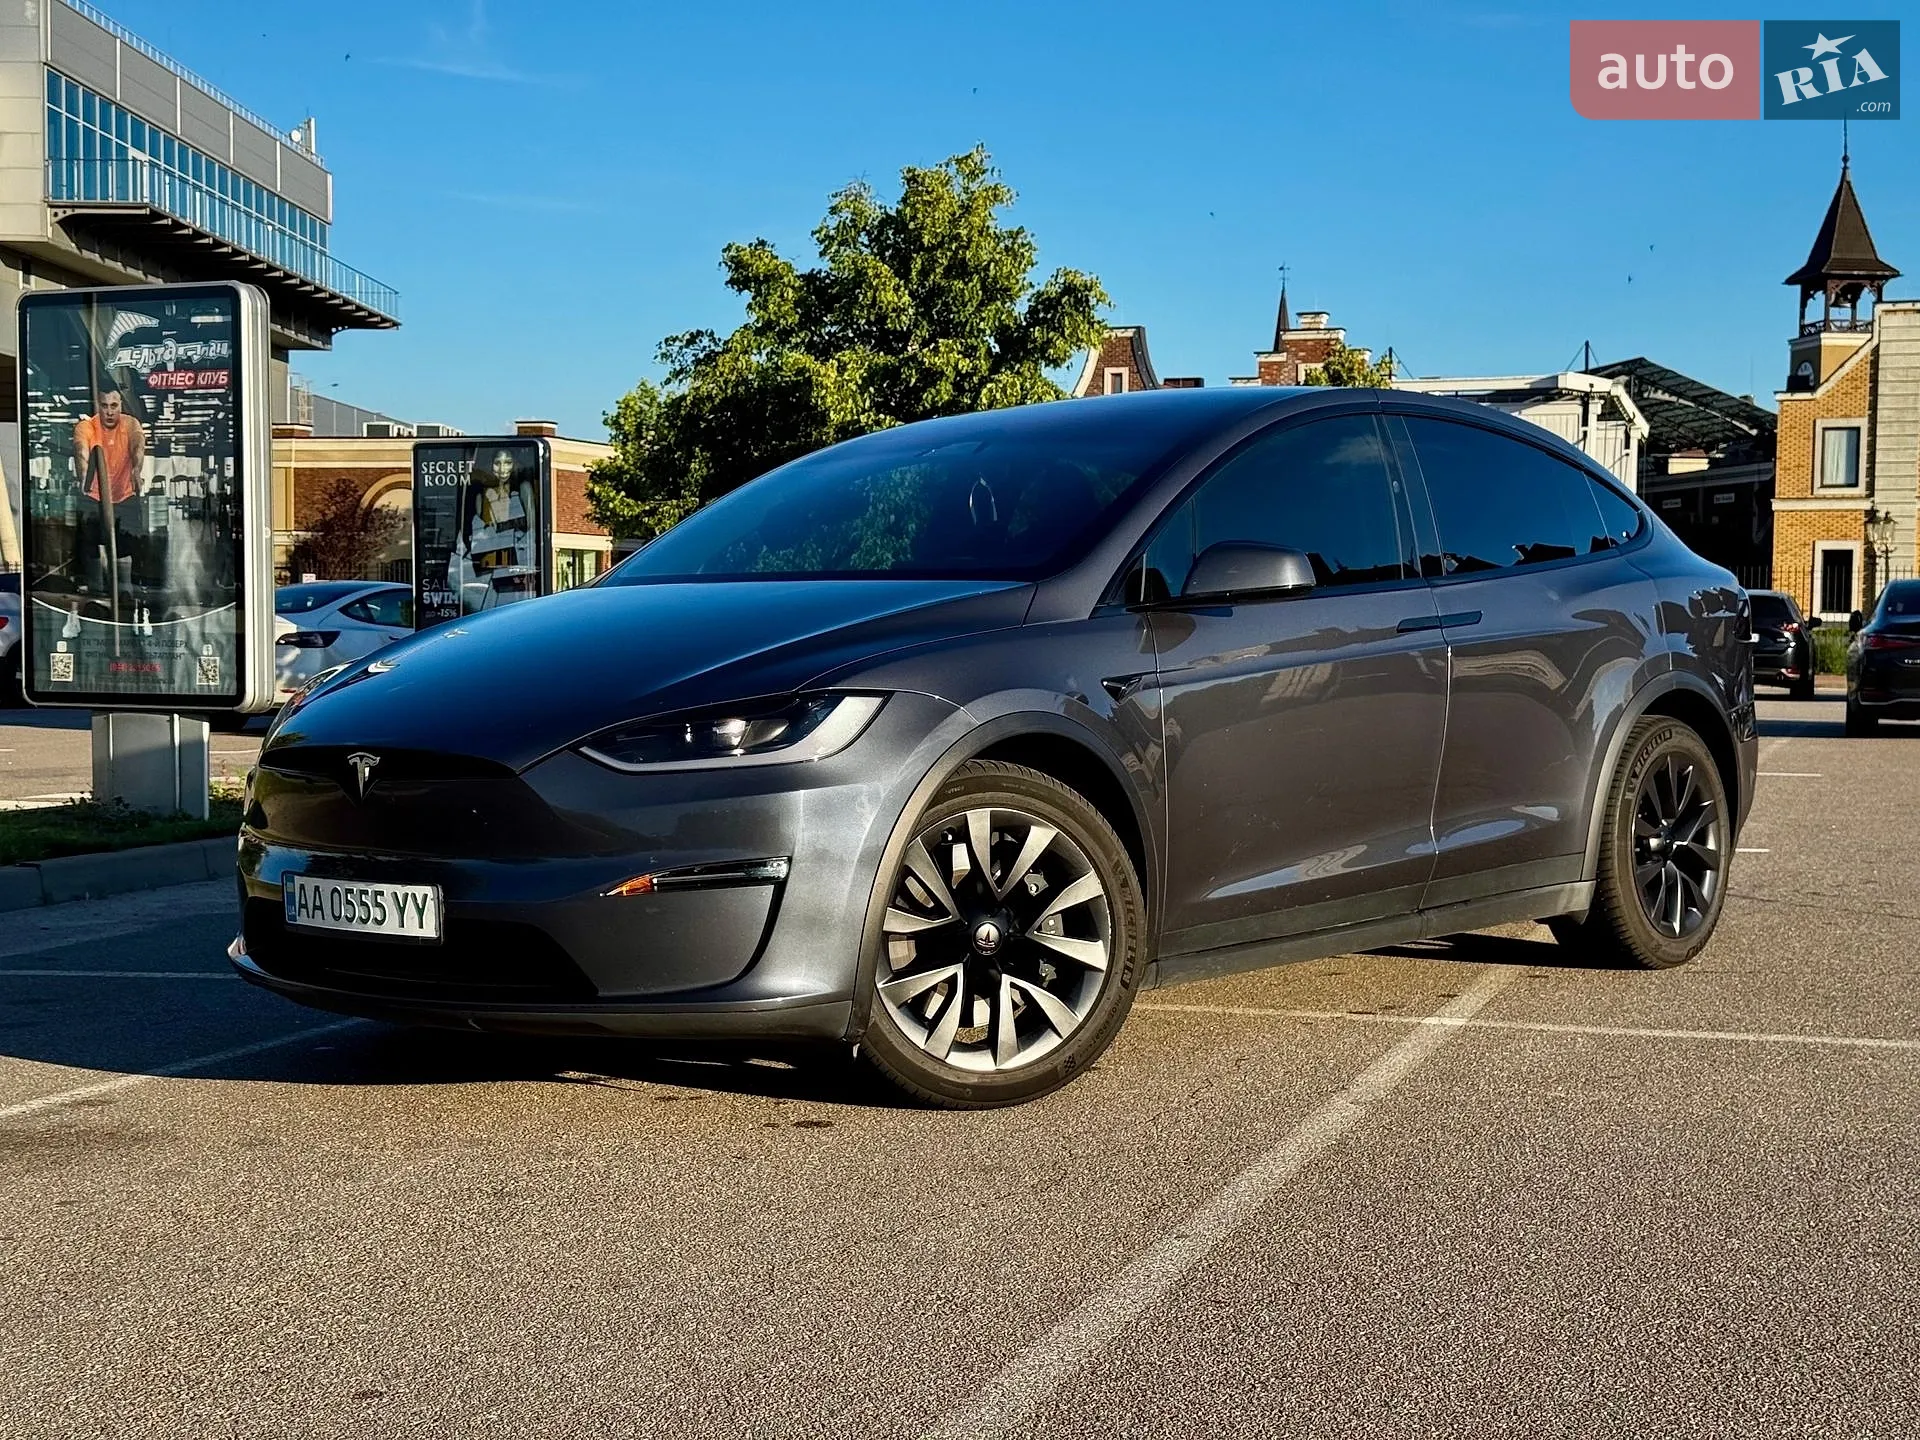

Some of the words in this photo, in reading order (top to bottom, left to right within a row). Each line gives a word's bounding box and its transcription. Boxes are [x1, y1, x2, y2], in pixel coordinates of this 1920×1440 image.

[148, 372, 195, 386] ФІТНЕС
[196, 371, 228, 385] КЛУБ
[421, 460, 475, 474] SECRET
[424, 474, 472, 487] ROOM
[422, 578, 452, 591] SAL
[298, 883, 325, 921] AA
[330, 886, 387, 926] 0555
[391, 891, 429, 929] YY
